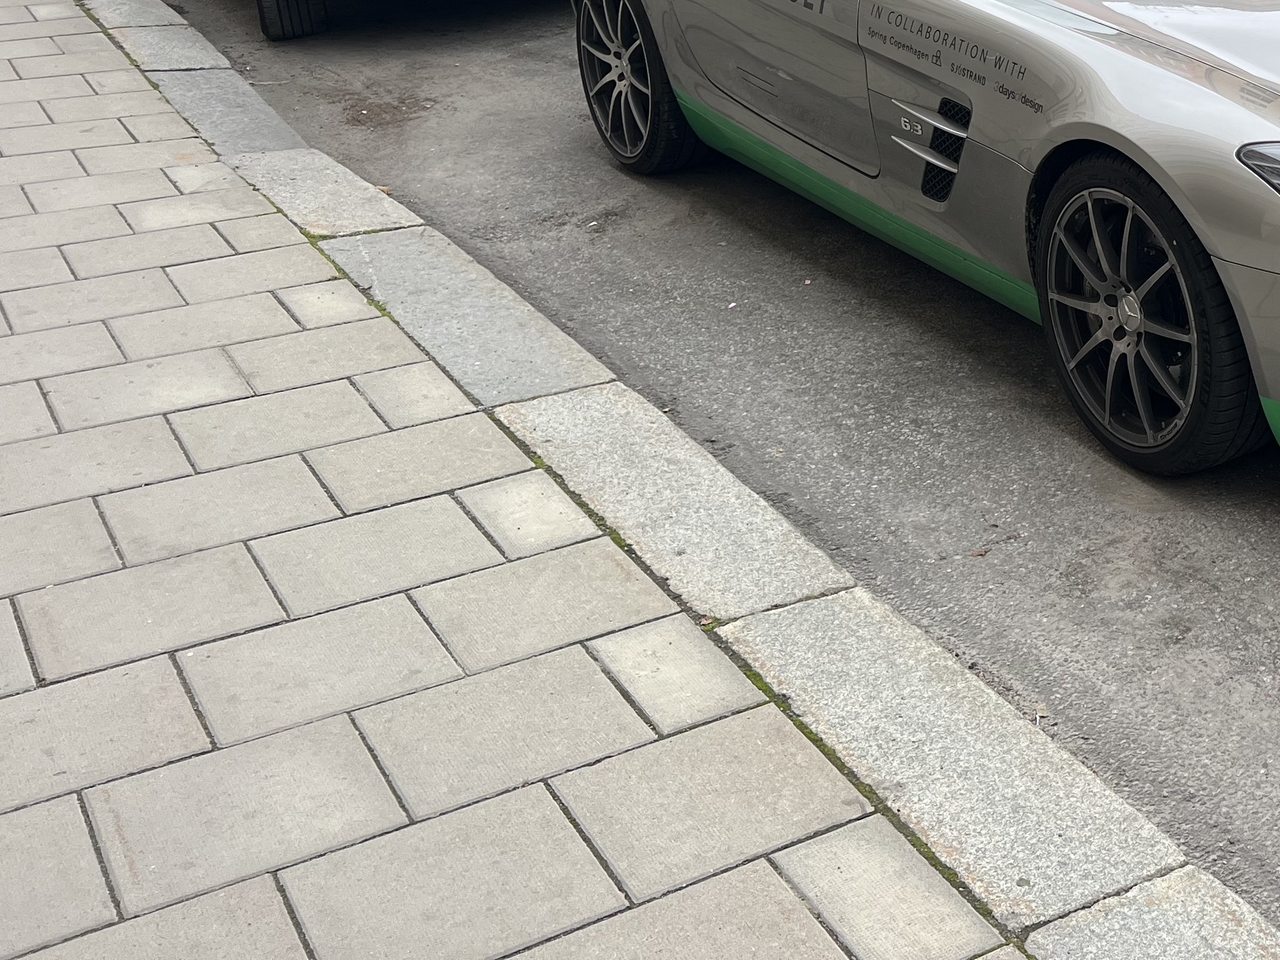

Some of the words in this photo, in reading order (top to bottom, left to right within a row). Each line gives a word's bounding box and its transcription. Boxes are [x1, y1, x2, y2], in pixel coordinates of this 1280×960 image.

[867, 26, 887, 45] Spring
[889, 35, 930, 62] Copenhagen
[870, 4, 884, 20] IN
[887, 10, 989, 64] COLLABORATION
[994, 55, 1027, 81] WITH
